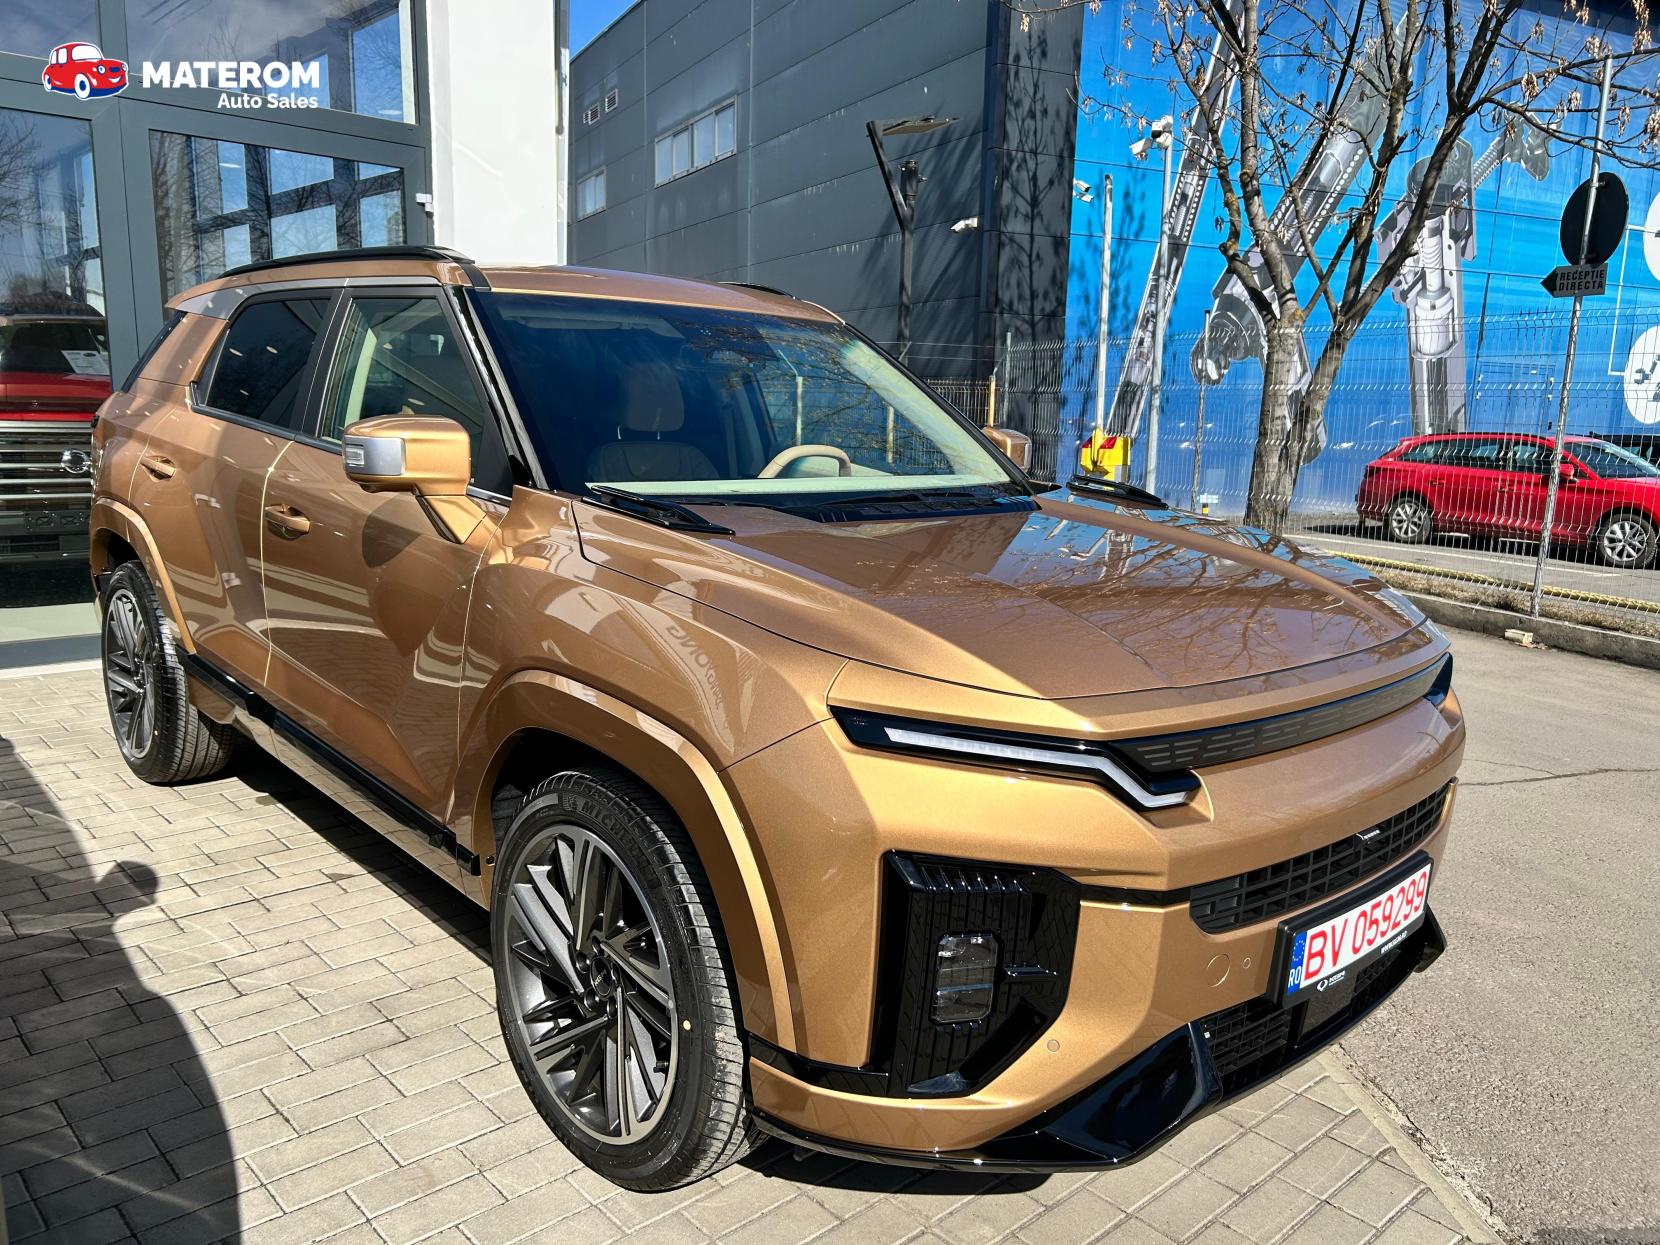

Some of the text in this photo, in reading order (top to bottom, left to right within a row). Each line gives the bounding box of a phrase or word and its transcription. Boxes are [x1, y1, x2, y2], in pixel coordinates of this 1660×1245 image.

[1560, 270, 1605, 281] RECEPTIE
[1558, 281, 1603, 291] DIRECTA
[1304, 871, 1427, 981] BV 059299
[1287, 965, 1302, 988] RO
